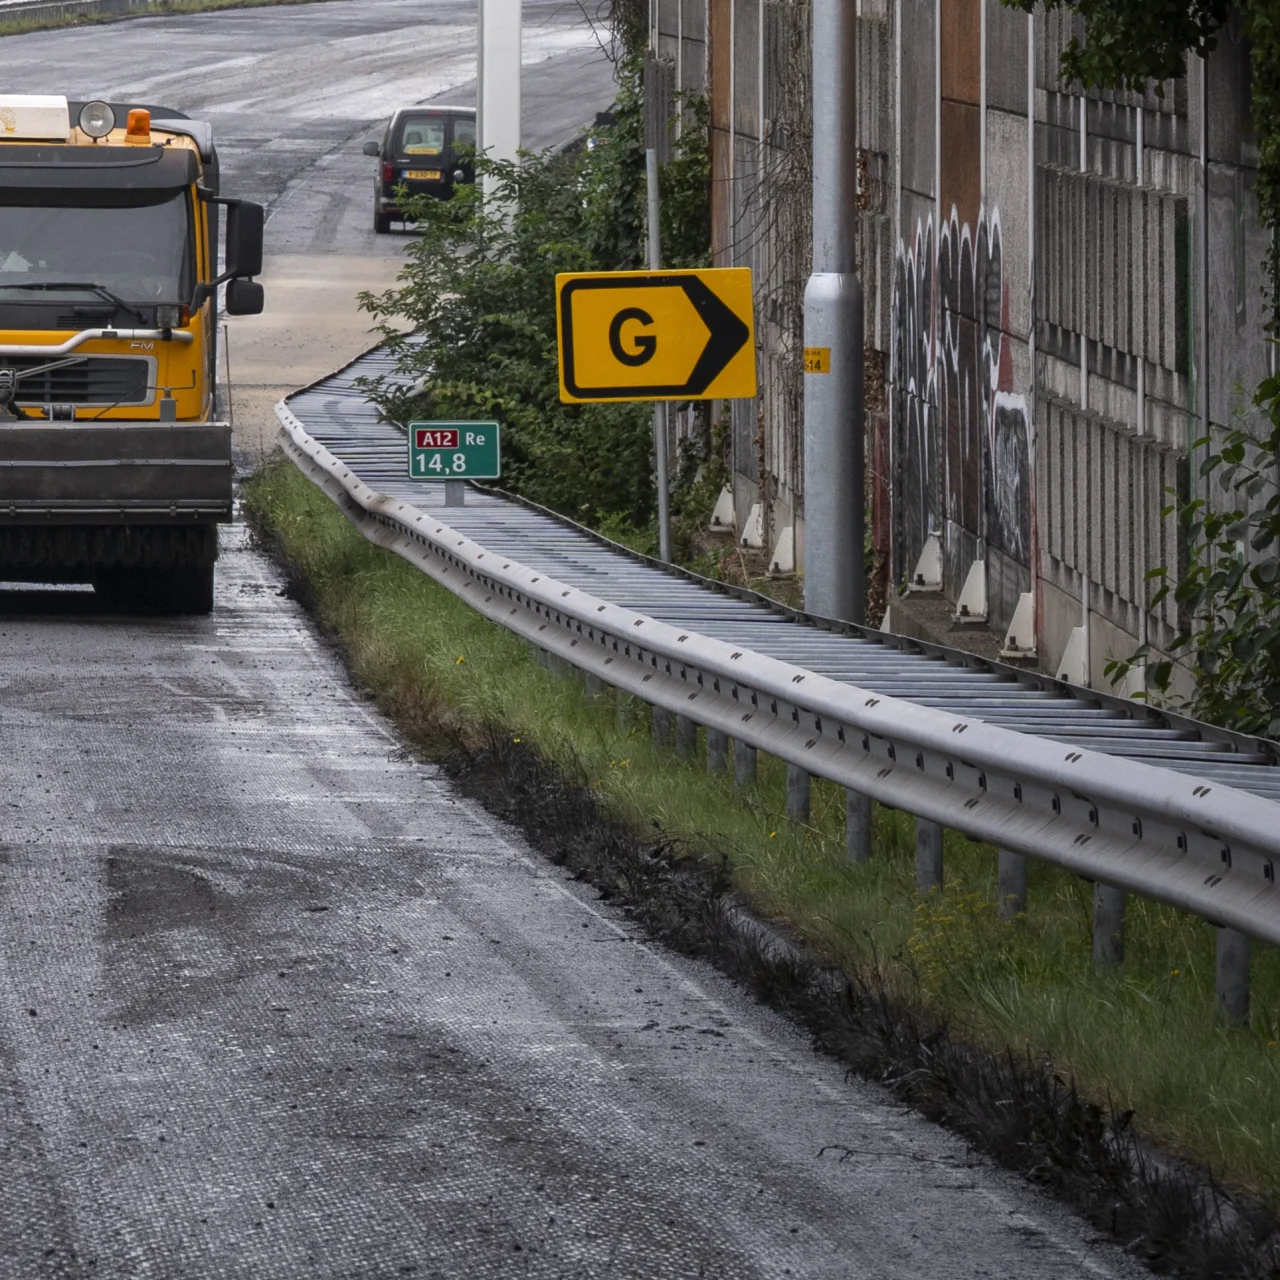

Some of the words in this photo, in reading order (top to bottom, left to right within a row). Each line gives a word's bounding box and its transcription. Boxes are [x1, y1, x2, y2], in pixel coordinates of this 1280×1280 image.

[130, 341, 154, 350] FM
[608, 307, 657, 367] G
[423, 432, 452, 446] A12
[465, 432, 486, 446] Re
[416, 453, 466, 475] 14,8
